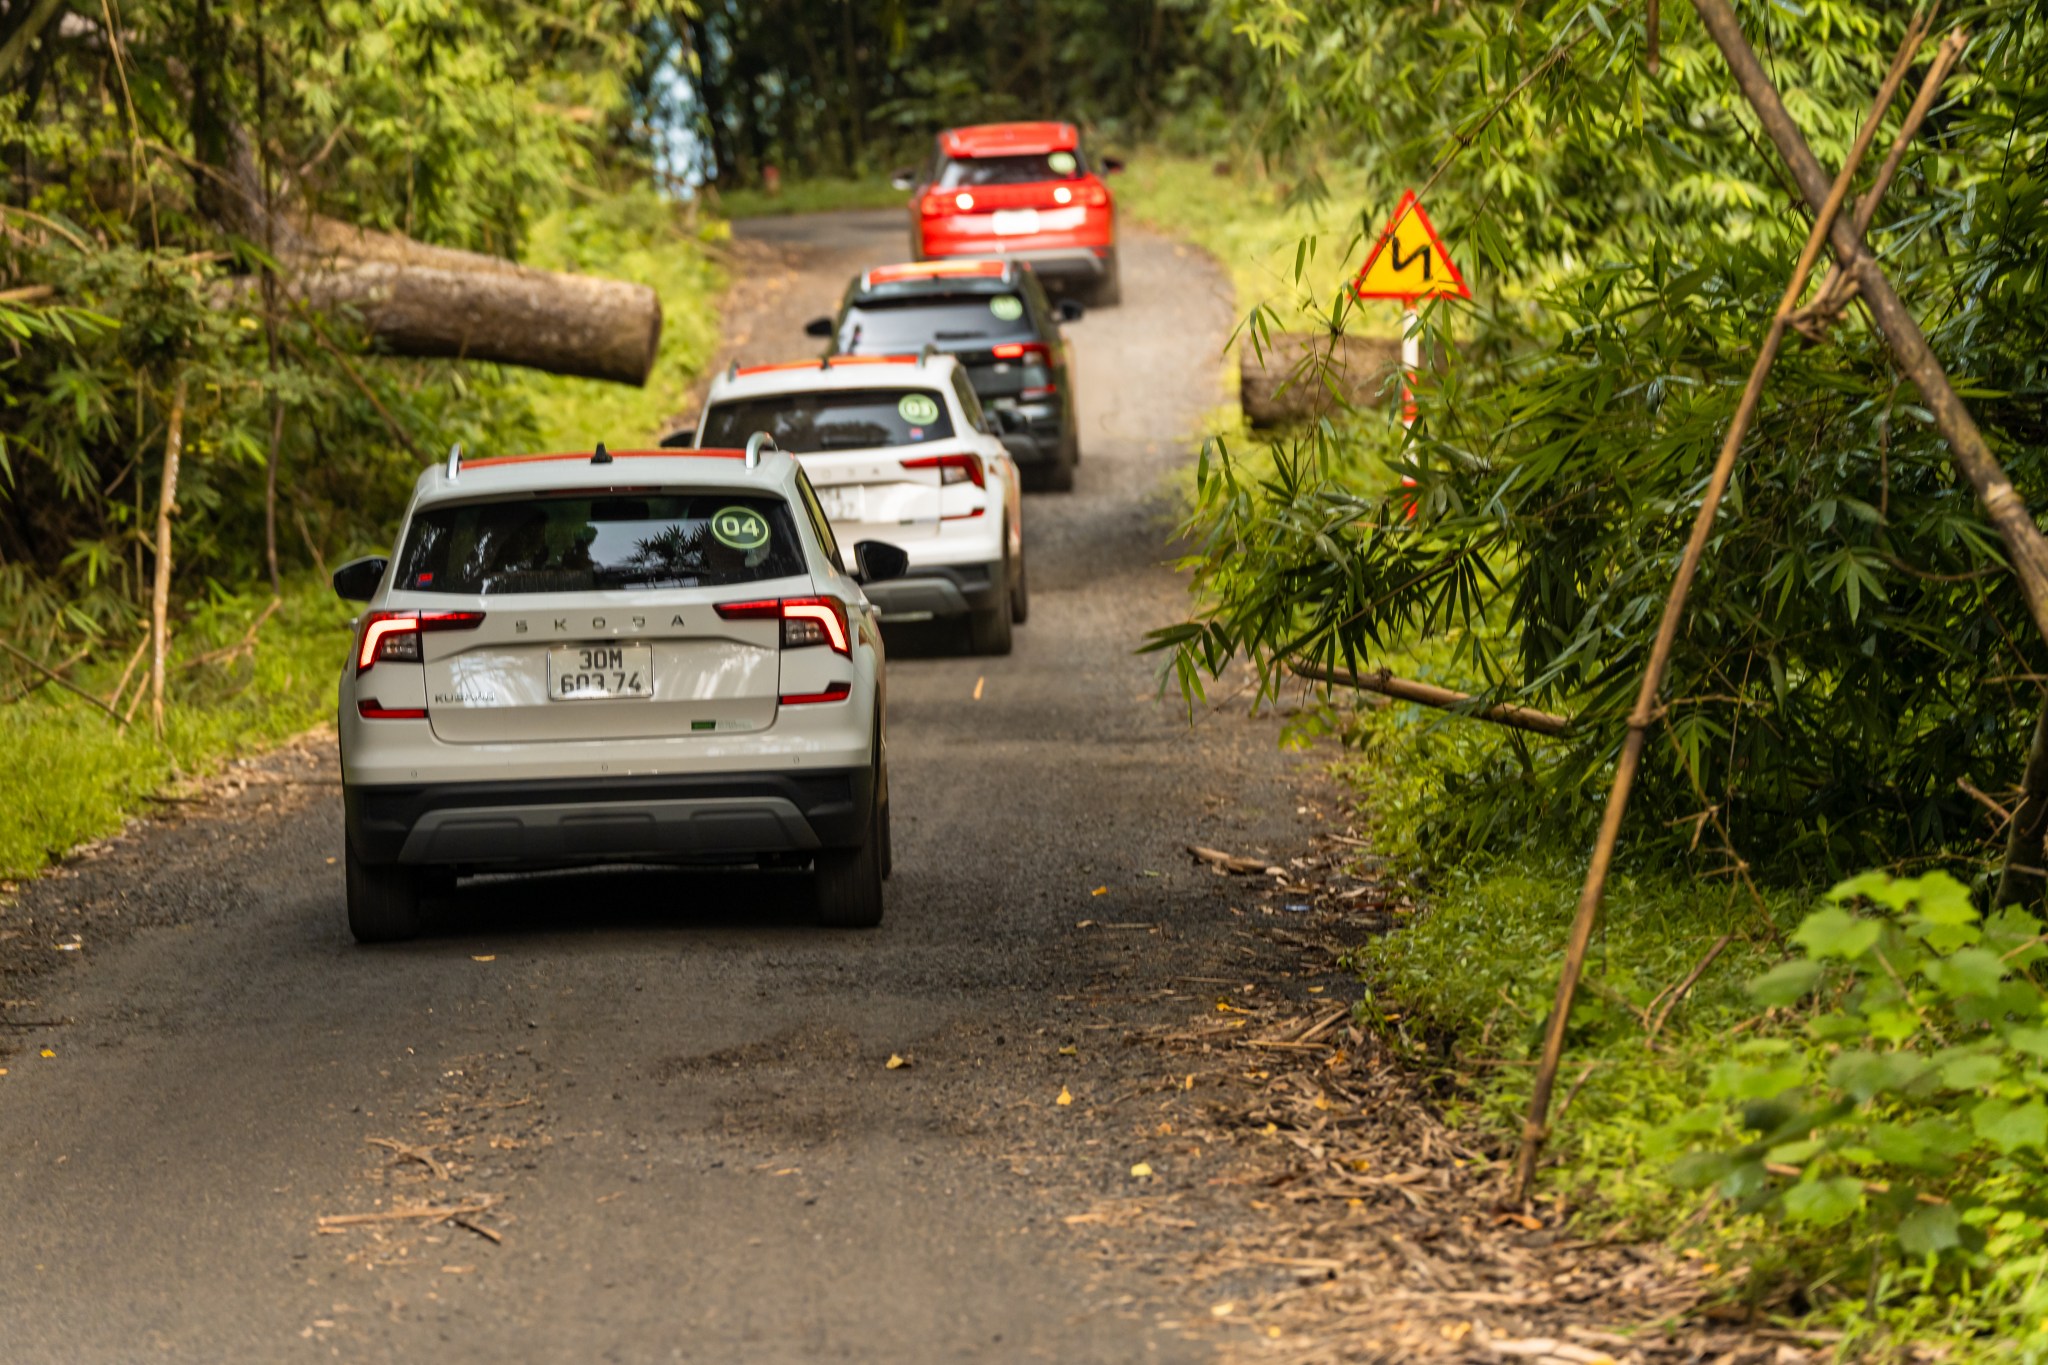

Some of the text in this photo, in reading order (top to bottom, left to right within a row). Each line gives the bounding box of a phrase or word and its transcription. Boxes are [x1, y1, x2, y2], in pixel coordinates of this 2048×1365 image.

[721, 516, 760, 537] 04
[515, 614, 685, 634] SKODA
[579, 648, 623, 670] 30M
[560, 671, 642, 695] 603.74
